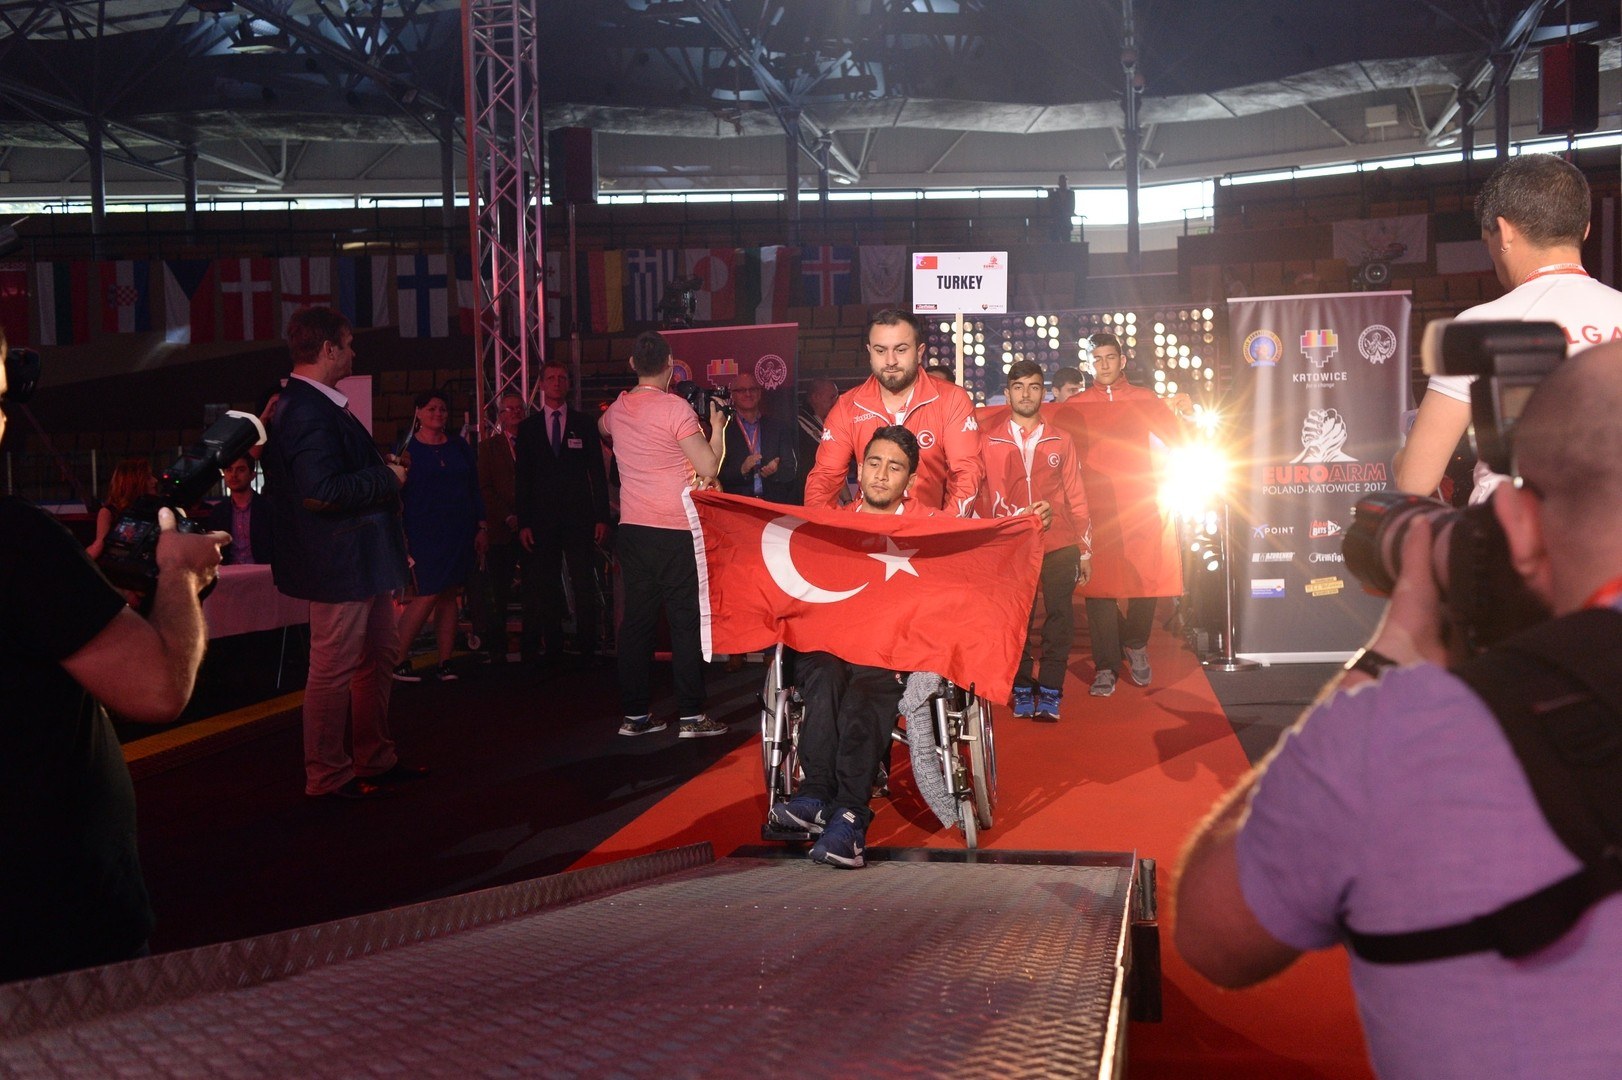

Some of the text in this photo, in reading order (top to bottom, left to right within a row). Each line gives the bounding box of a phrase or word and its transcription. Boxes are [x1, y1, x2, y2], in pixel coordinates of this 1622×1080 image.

[937, 275, 983, 289] TURKEY
[1292, 371, 1348, 383] KATOWICE
[1262, 463, 1387, 484] EUROARM
[1262, 482, 1387, 495] POLAND-KATOWICE 2017
